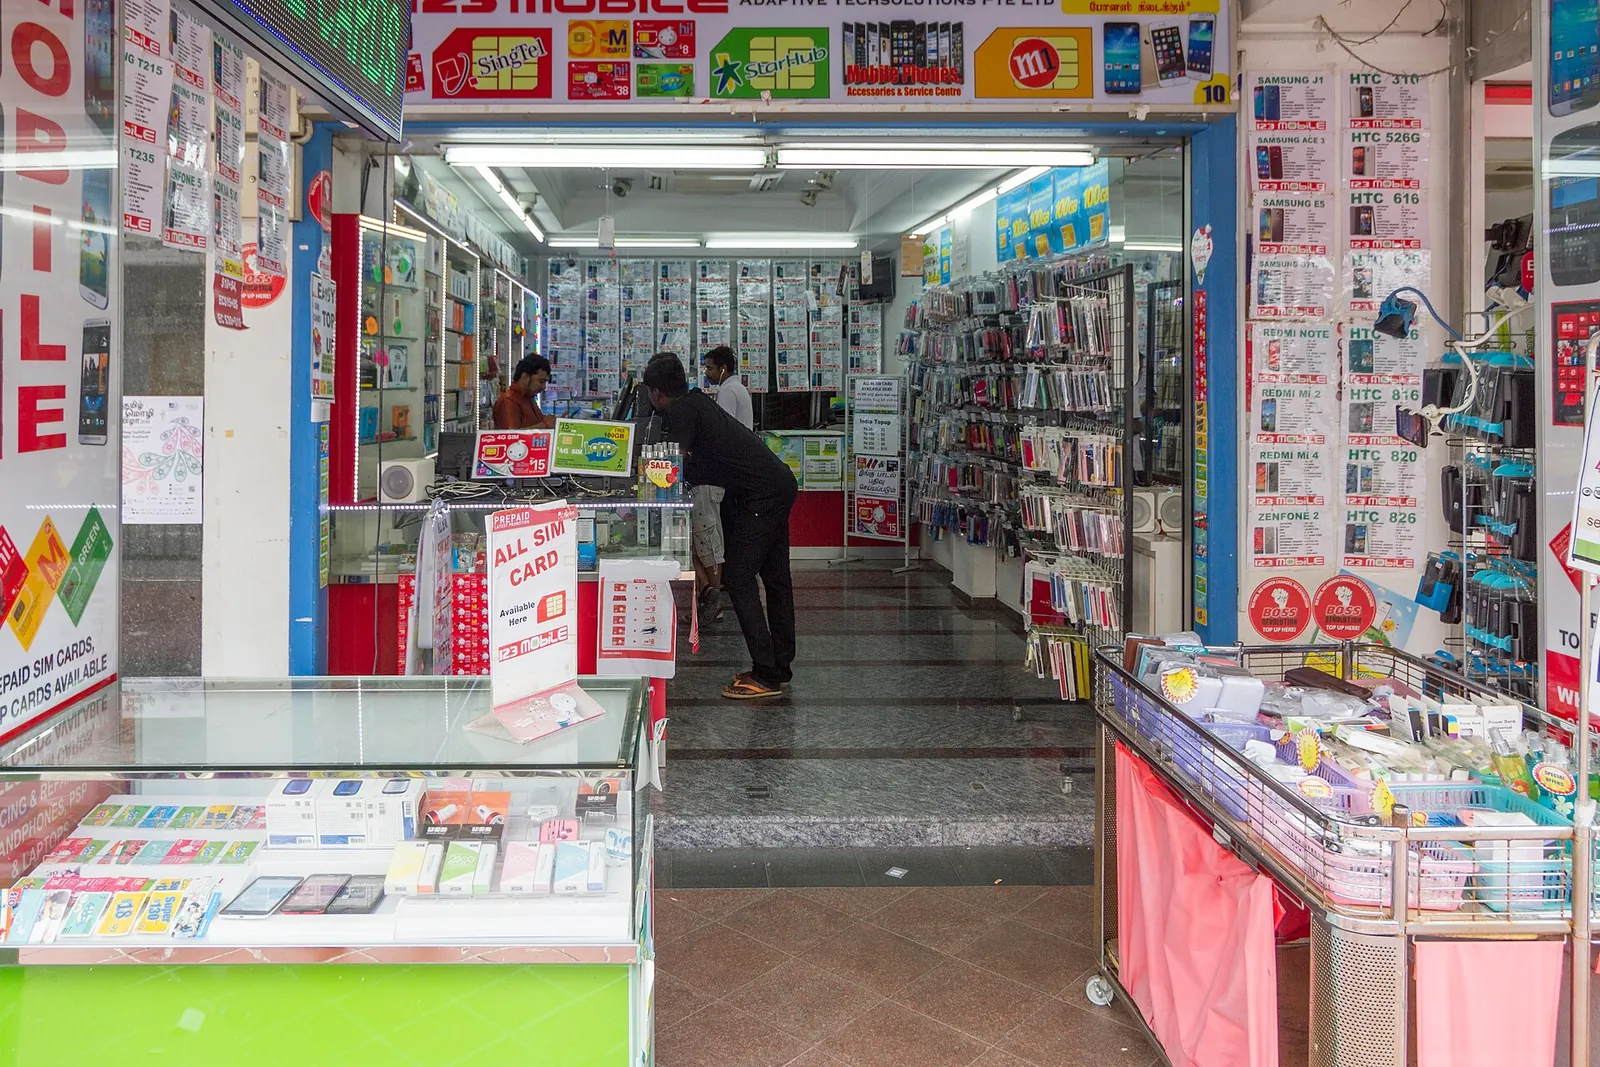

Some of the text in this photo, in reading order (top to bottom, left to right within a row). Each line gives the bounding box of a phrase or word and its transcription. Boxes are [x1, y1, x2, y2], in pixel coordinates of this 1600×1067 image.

[478, 38, 547, 75] SingTel
[745, 48, 826, 78] StarHub
[138, 58, 163, 76] T215
[847, 65, 897, 83] Mobile
[1312, 76, 1323, 84] J1
[1350, 74, 1419, 84] HTC 310
[847, 87, 961, 96] Accessories & Service Centre
[1203, 86, 1225, 102] 10
[1256, 122, 1274, 130] 123
[1352, 133, 1420, 142] HTC 526G
[130, 148, 155, 164] T235
[1263, 199, 1311, 207] SAMSUNG
[1350, 194, 1419, 204] HTC 616
[1264, 328, 1329, 339] REDMI NOTE
[1350, 328, 1381, 339] HTC
[1262, 389, 1321, 398] REDMI Mi 2
[1350, 390, 1419, 400] HTC 816
[532, 436, 547, 448] hi!
[1349, 450, 1417, 462] HTC 820
[650, 462, 670, 470] SALE
[494, 512, 530, 526] PREPAID
[1258, 512, 1319, 521] ZENFONE 2
[1347, 511, 1416, 524] HTC 826
[78, 520, 101, 566] GREEN
[495, 521, 566, 568] ALL SIM
[37, 533, 65, 585] M
[1344, 558, 1363, 566] 123
[50, 556, 68, 591] CARD
[510, 550, 559, 587] CARD
[500, 600, 536, 618] Available
[1262, 607, 1298, 618] BOSS
[1326, 604, 1362, 616] BOSS
[508, 614, 528, 627] Here
[34, 654, 54, 678] SIM
[56, 636, 95, 667] CARDS,
[499, 646, 519, 661] 123
[11, 654, 108, 719] CARDS AVAILABLE
[30, 789, 37, 808] &
[70, 783, 88, 808] PSP
